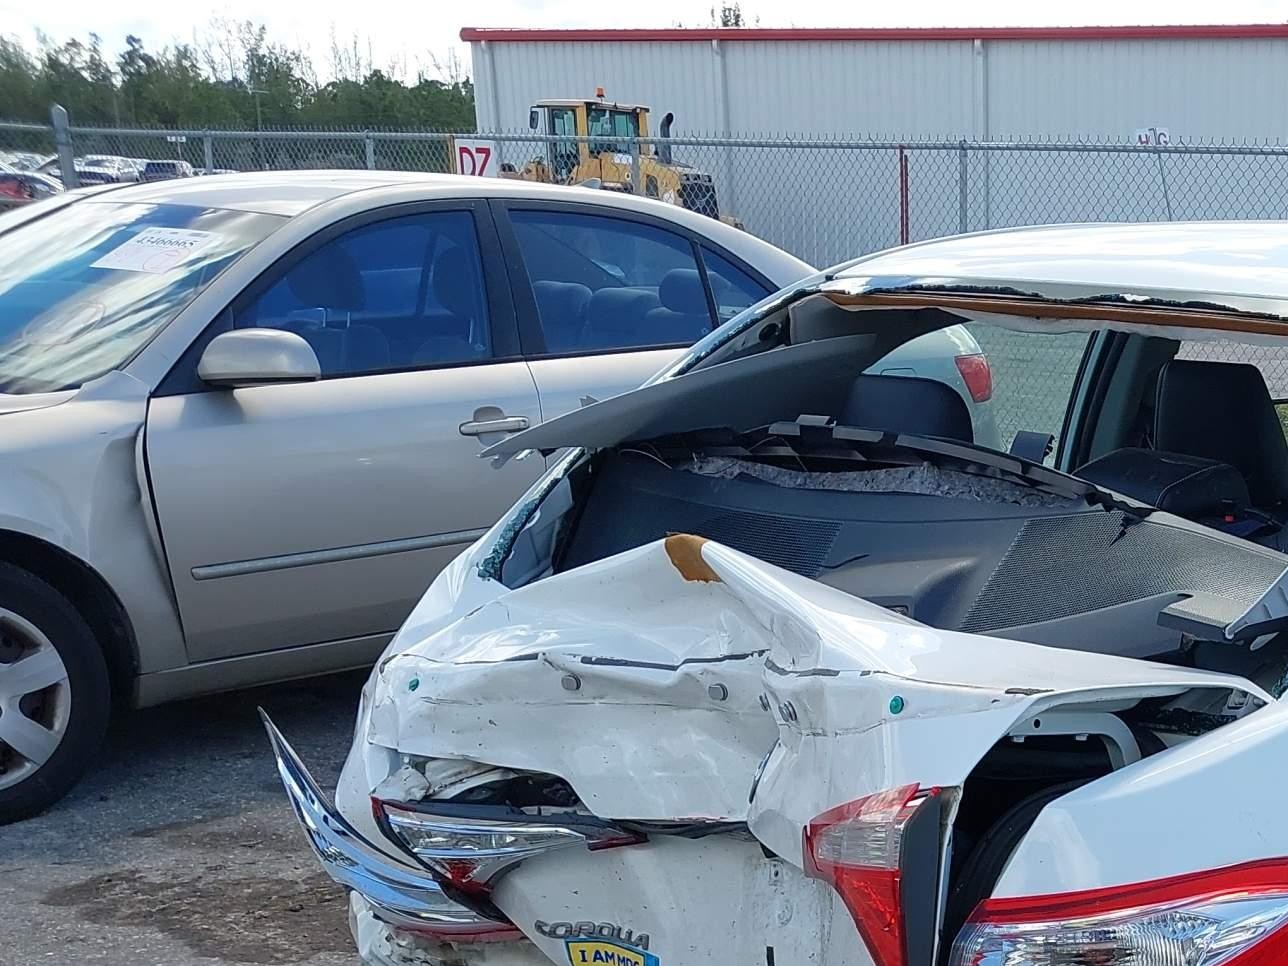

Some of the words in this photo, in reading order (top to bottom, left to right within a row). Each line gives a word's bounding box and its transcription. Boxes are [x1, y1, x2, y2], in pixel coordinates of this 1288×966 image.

[534, 919, 650, 951] COROLLA
[579, 949, 588, 963] I
[592, 949, 616, 966] AM
